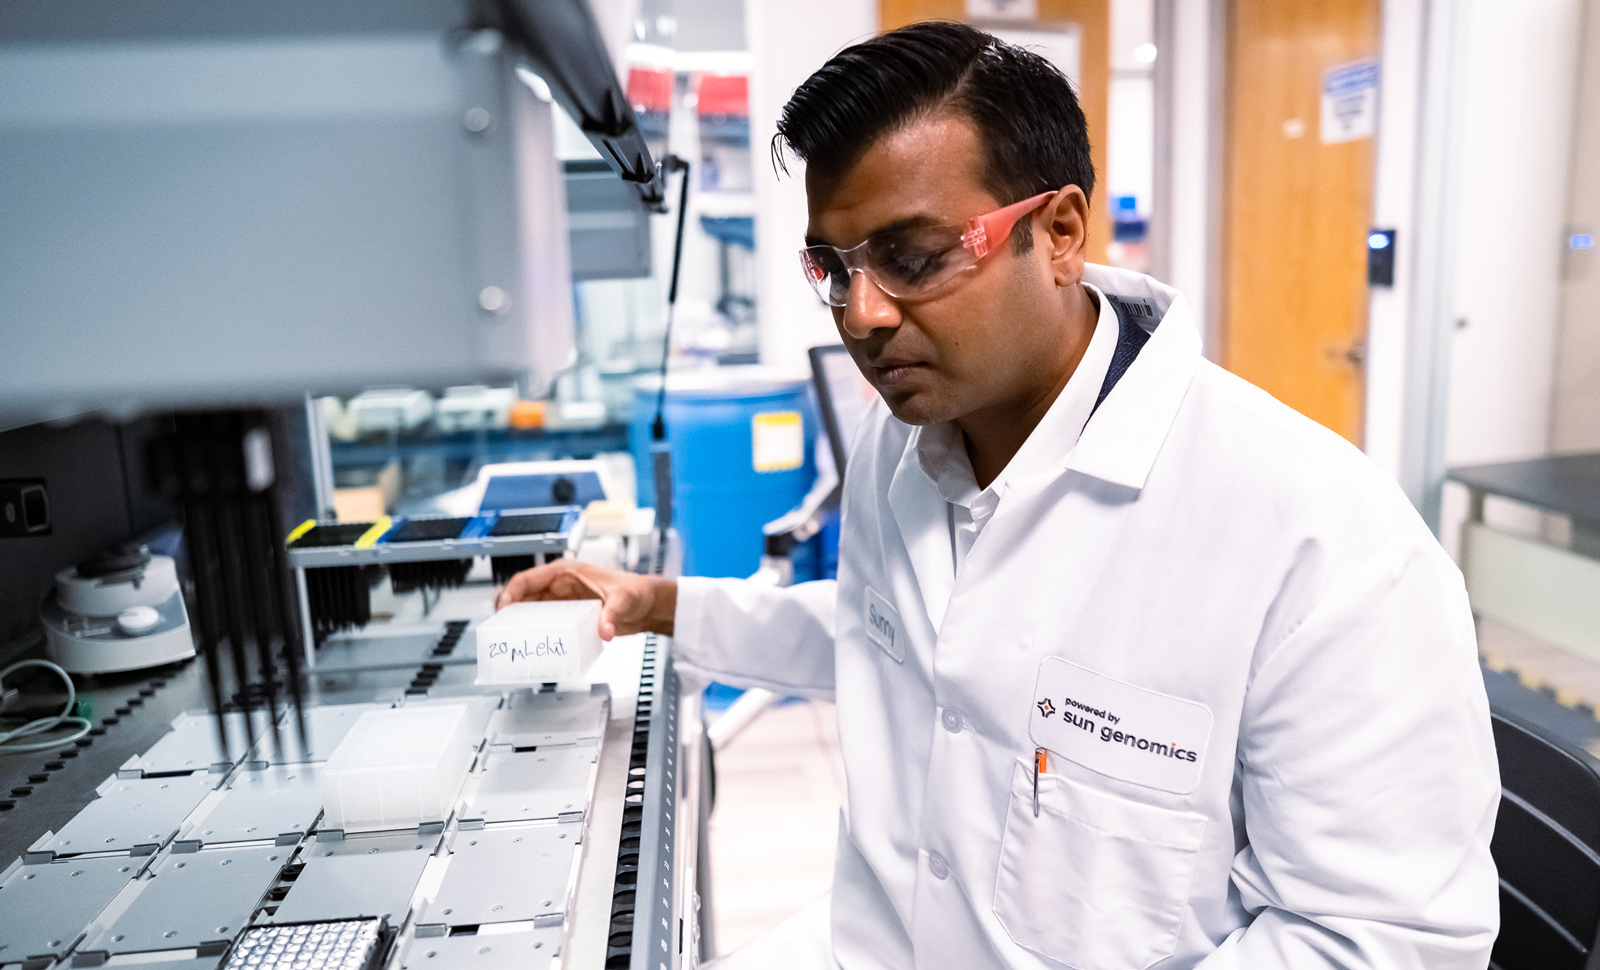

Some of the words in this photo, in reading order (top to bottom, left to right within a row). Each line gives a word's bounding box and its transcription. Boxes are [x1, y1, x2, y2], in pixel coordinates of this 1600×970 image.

[869, 603, 895, 647] Sunny
[1064, 697, 1106, 719] powered
[1107, 712, 1121, 725] by
[1063, 710, 1095, 733] sun
[1100, 726, 1198, 762] genomics
